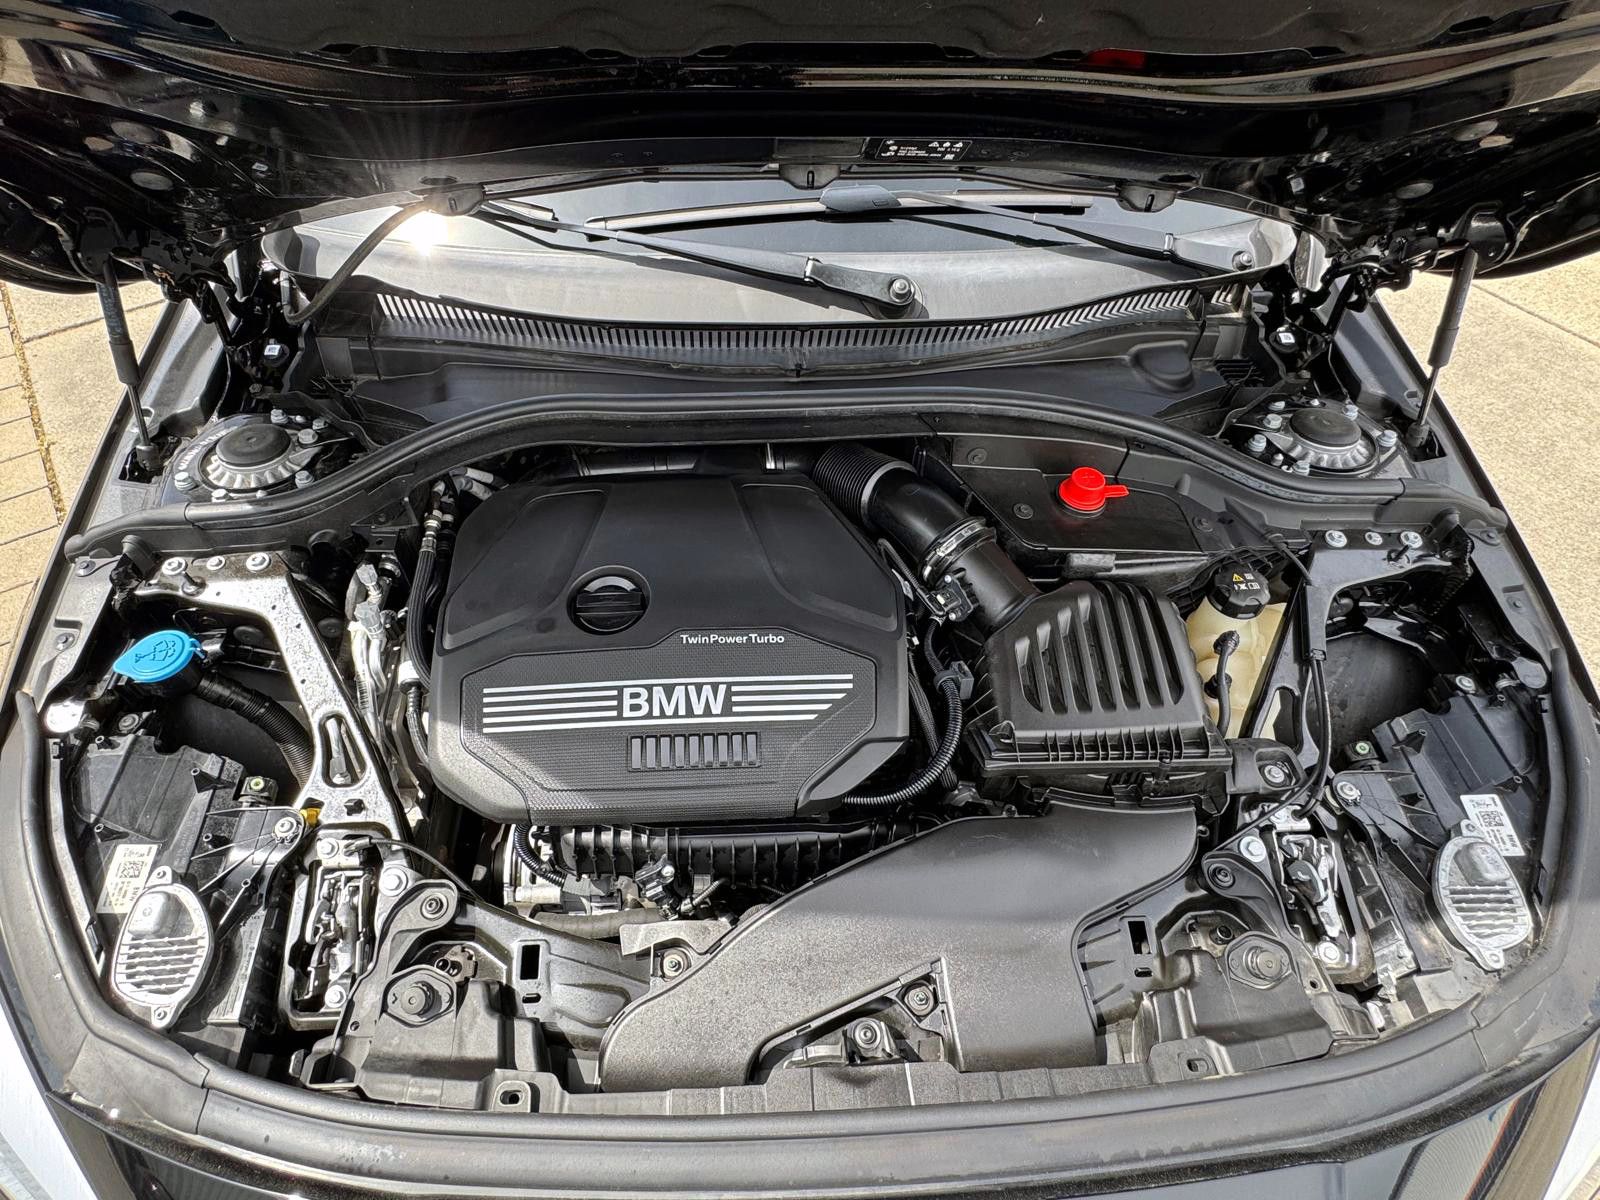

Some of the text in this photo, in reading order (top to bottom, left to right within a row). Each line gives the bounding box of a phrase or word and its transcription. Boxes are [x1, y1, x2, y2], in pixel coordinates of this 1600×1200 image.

[680, 633, 785, 644] TwinPower Turbo
[622, 684, 727, 718] BMW
